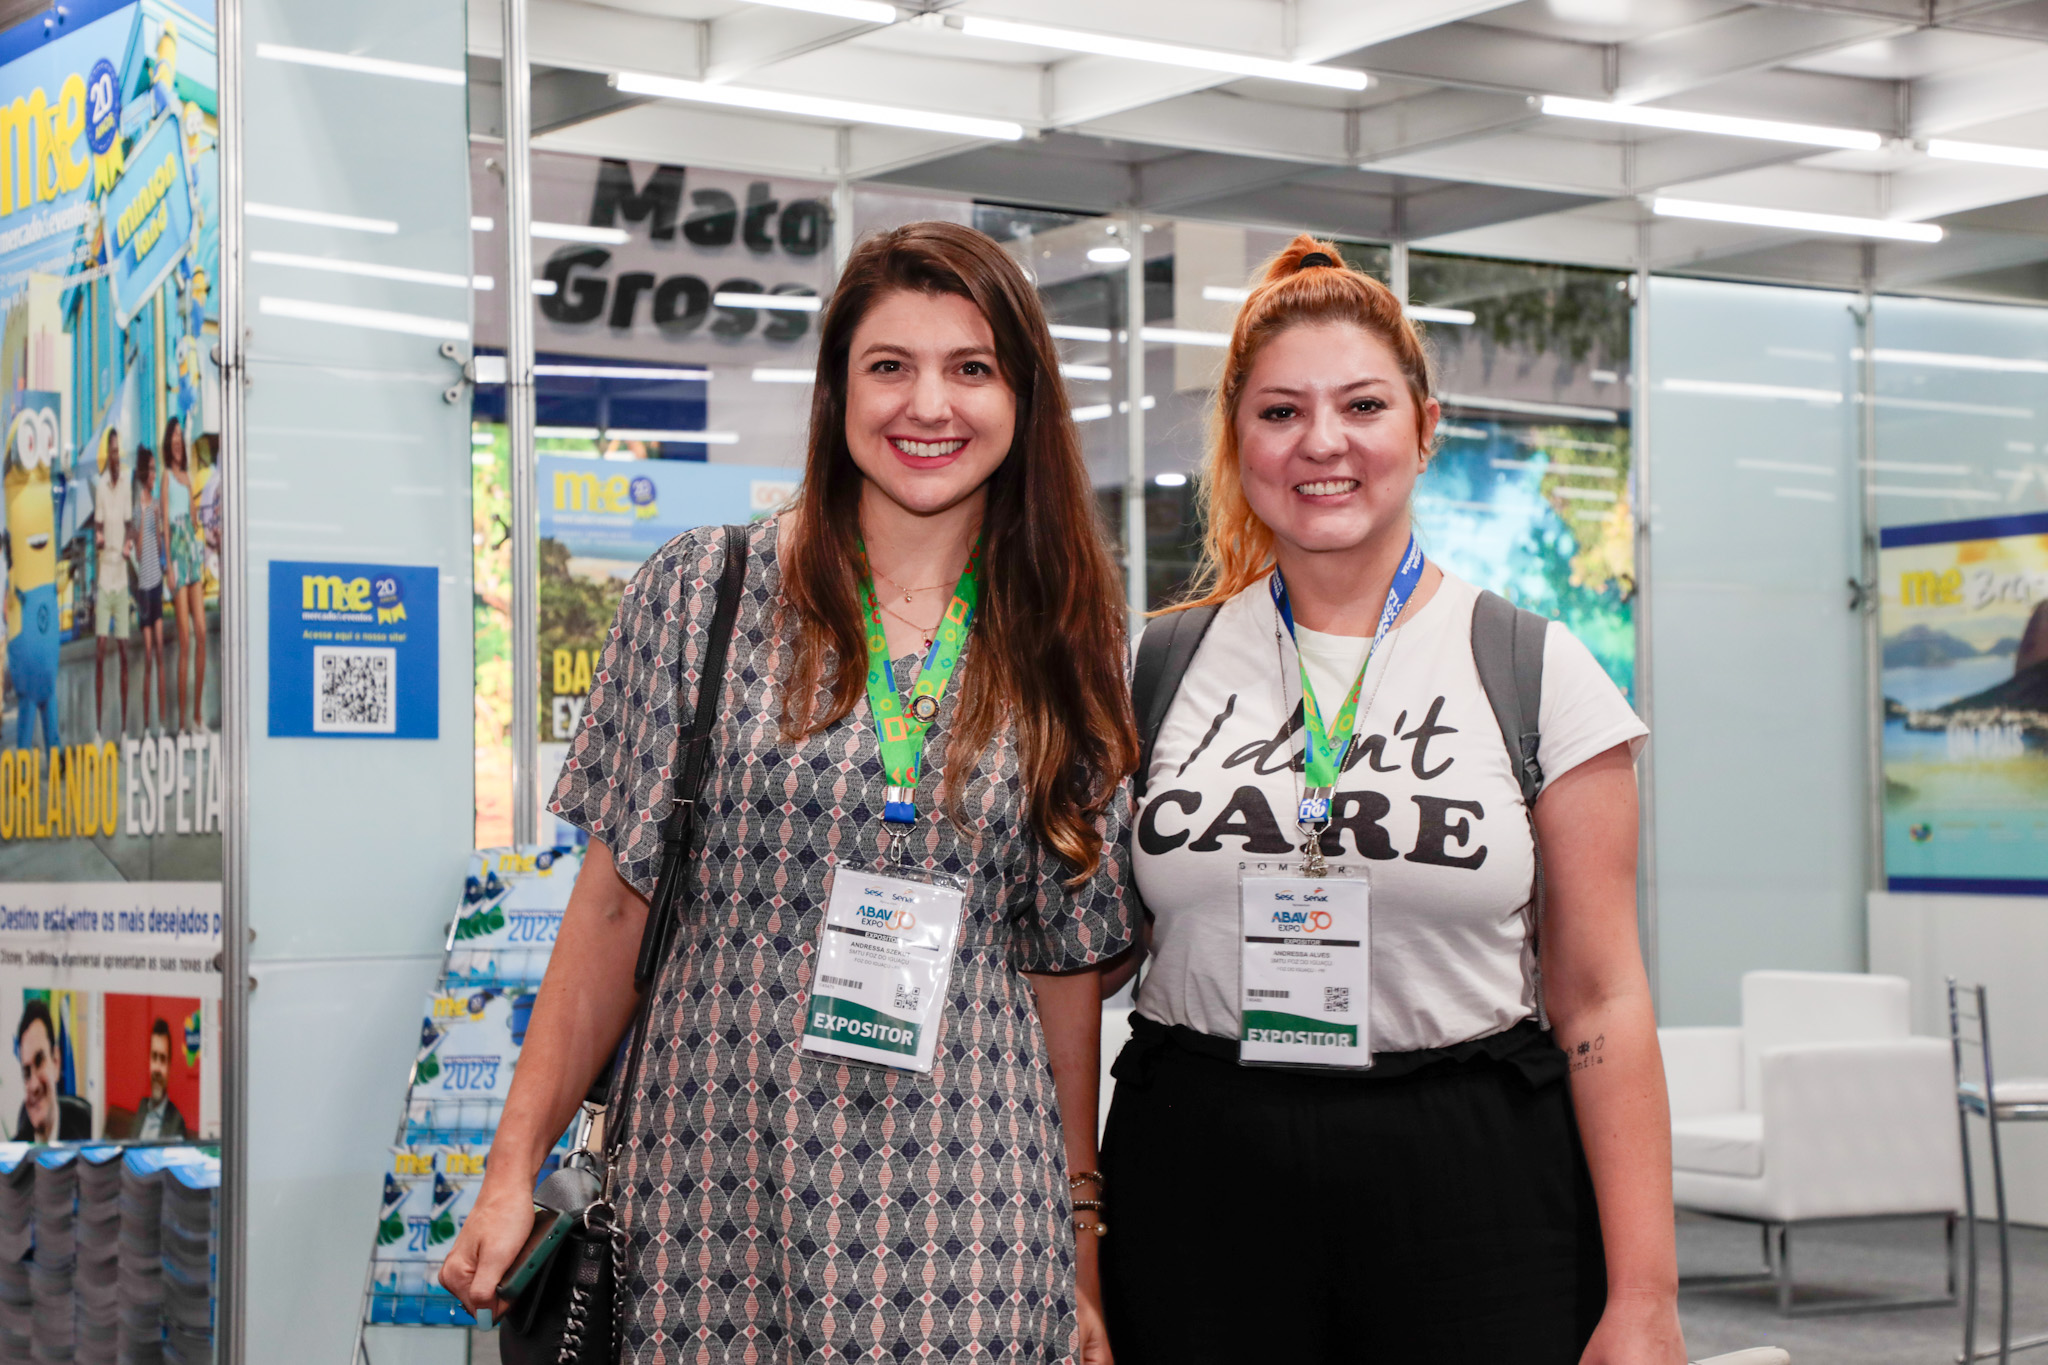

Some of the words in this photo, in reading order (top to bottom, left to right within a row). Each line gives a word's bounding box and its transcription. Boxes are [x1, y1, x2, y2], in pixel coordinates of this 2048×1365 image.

[89, 73, 114, 125] 20
[117, 152, 177, 248] minion
[588, 157, 828, 258] Mato
[133, 197, 168, 262] land
[539, 245, 820, 343] Gross
[302, 575, 373, 612] m&e
[376, 578, 397, 598] 20
[1176, 693, 1238, 778] I
[1221, 695, 1460, 781] dn't
[0, 740, 118, 840] ORLANDO
[126, 732, 223, 837] ESPETA
[1137, 785, 1488, 871] CARE
[864, 887, 884, 898] Sesc
[1274, 892, 1295, 901] Sesc
[1303, 894, 1329, 902] Senac
[102, 910, 115, 932] os
[118, 907, 145, 933] mais
[149, 907, 208, 941] desejados
[856, 904, 894, 921] ABAV
[861, 917, 884, 929] EXPO
[1271, 911, 1309, 924] ABAV
[865, 931, 900, 944] EXPOSITO
[1278, 924, 1301, 933] EXPO
[850, 941, 885, 953] ANDRESSA
[814, 1012, 914, 1047] EXPOSITOR
[1247, 1028, 1352, 1048] EXPOSITOR
[442, 1063, 500, 1090] 2023
